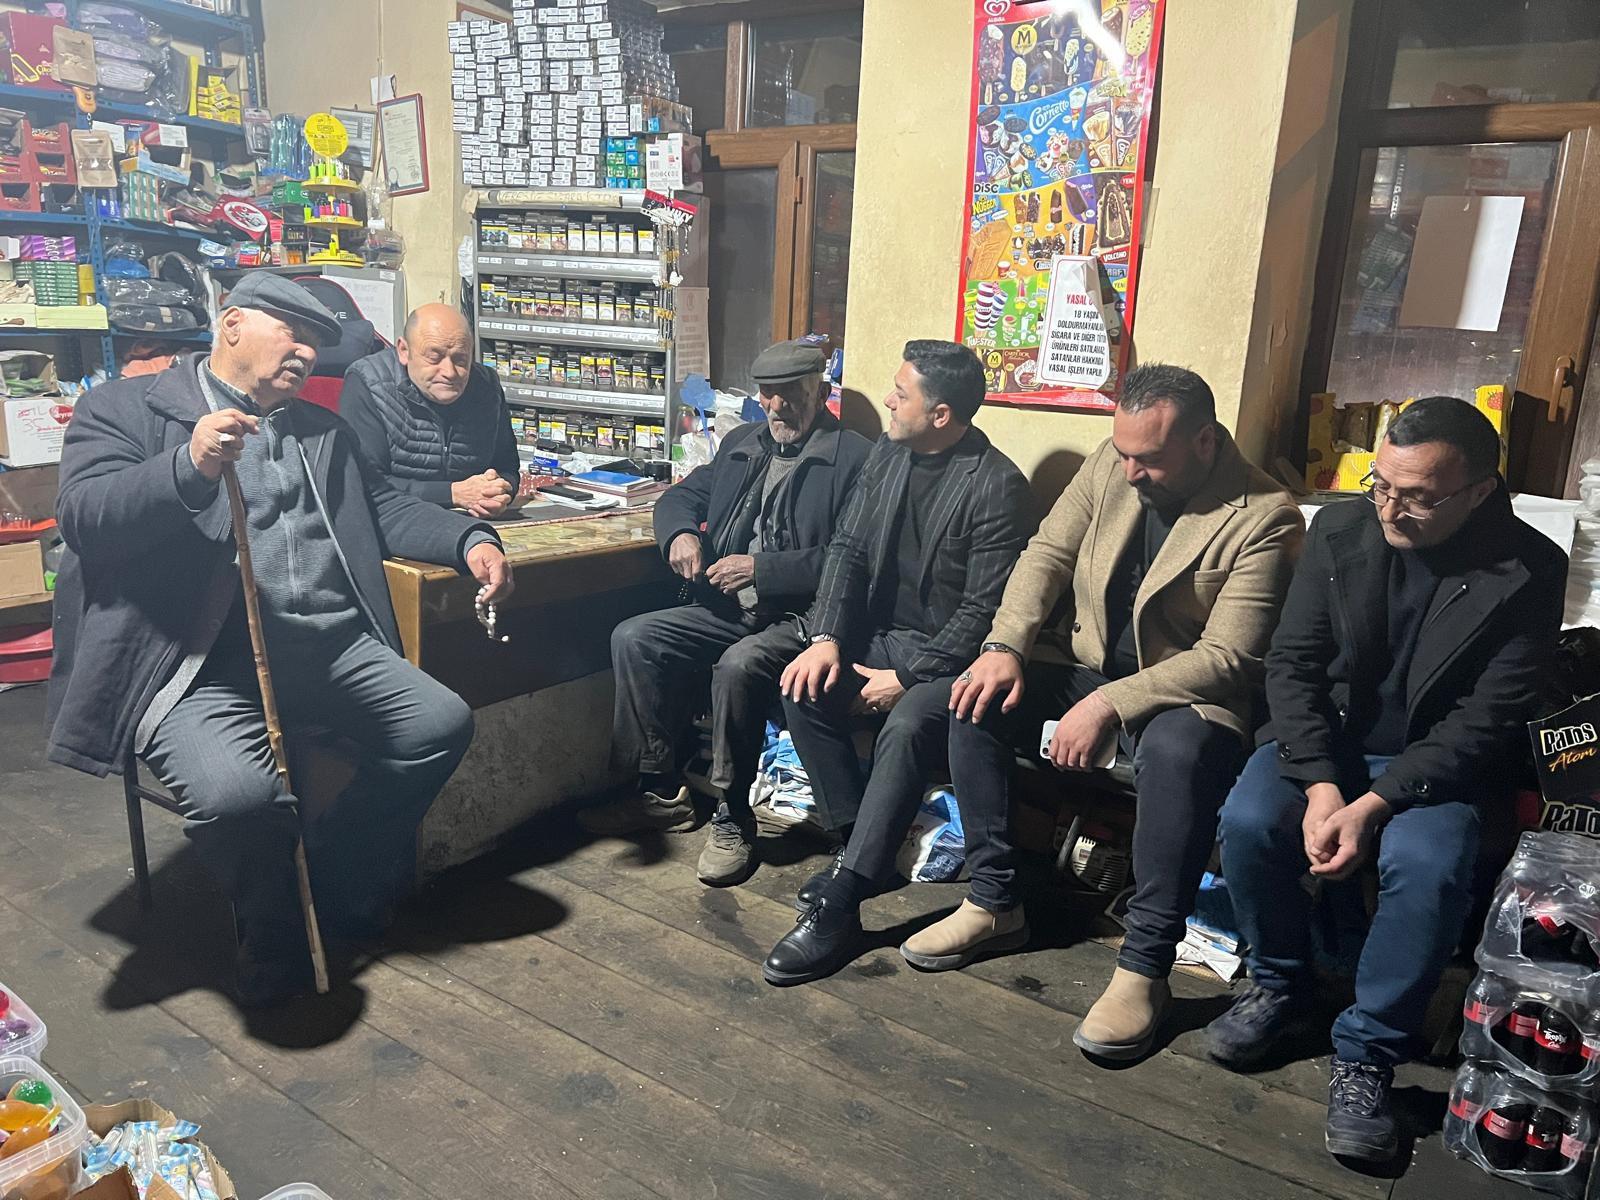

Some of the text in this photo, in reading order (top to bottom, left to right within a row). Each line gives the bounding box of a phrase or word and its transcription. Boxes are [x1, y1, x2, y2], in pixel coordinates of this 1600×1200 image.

[1066, 294, 1087, 305] YASAL
[1074, 310, 1081, 319] 18
[1073, 332, 1080, 341] VE
[1051, 352, 1081, 363] SATANLAR
[1048, 363, 1066, 373] YASAL
[1548, 746, 1598, 773] Atom
